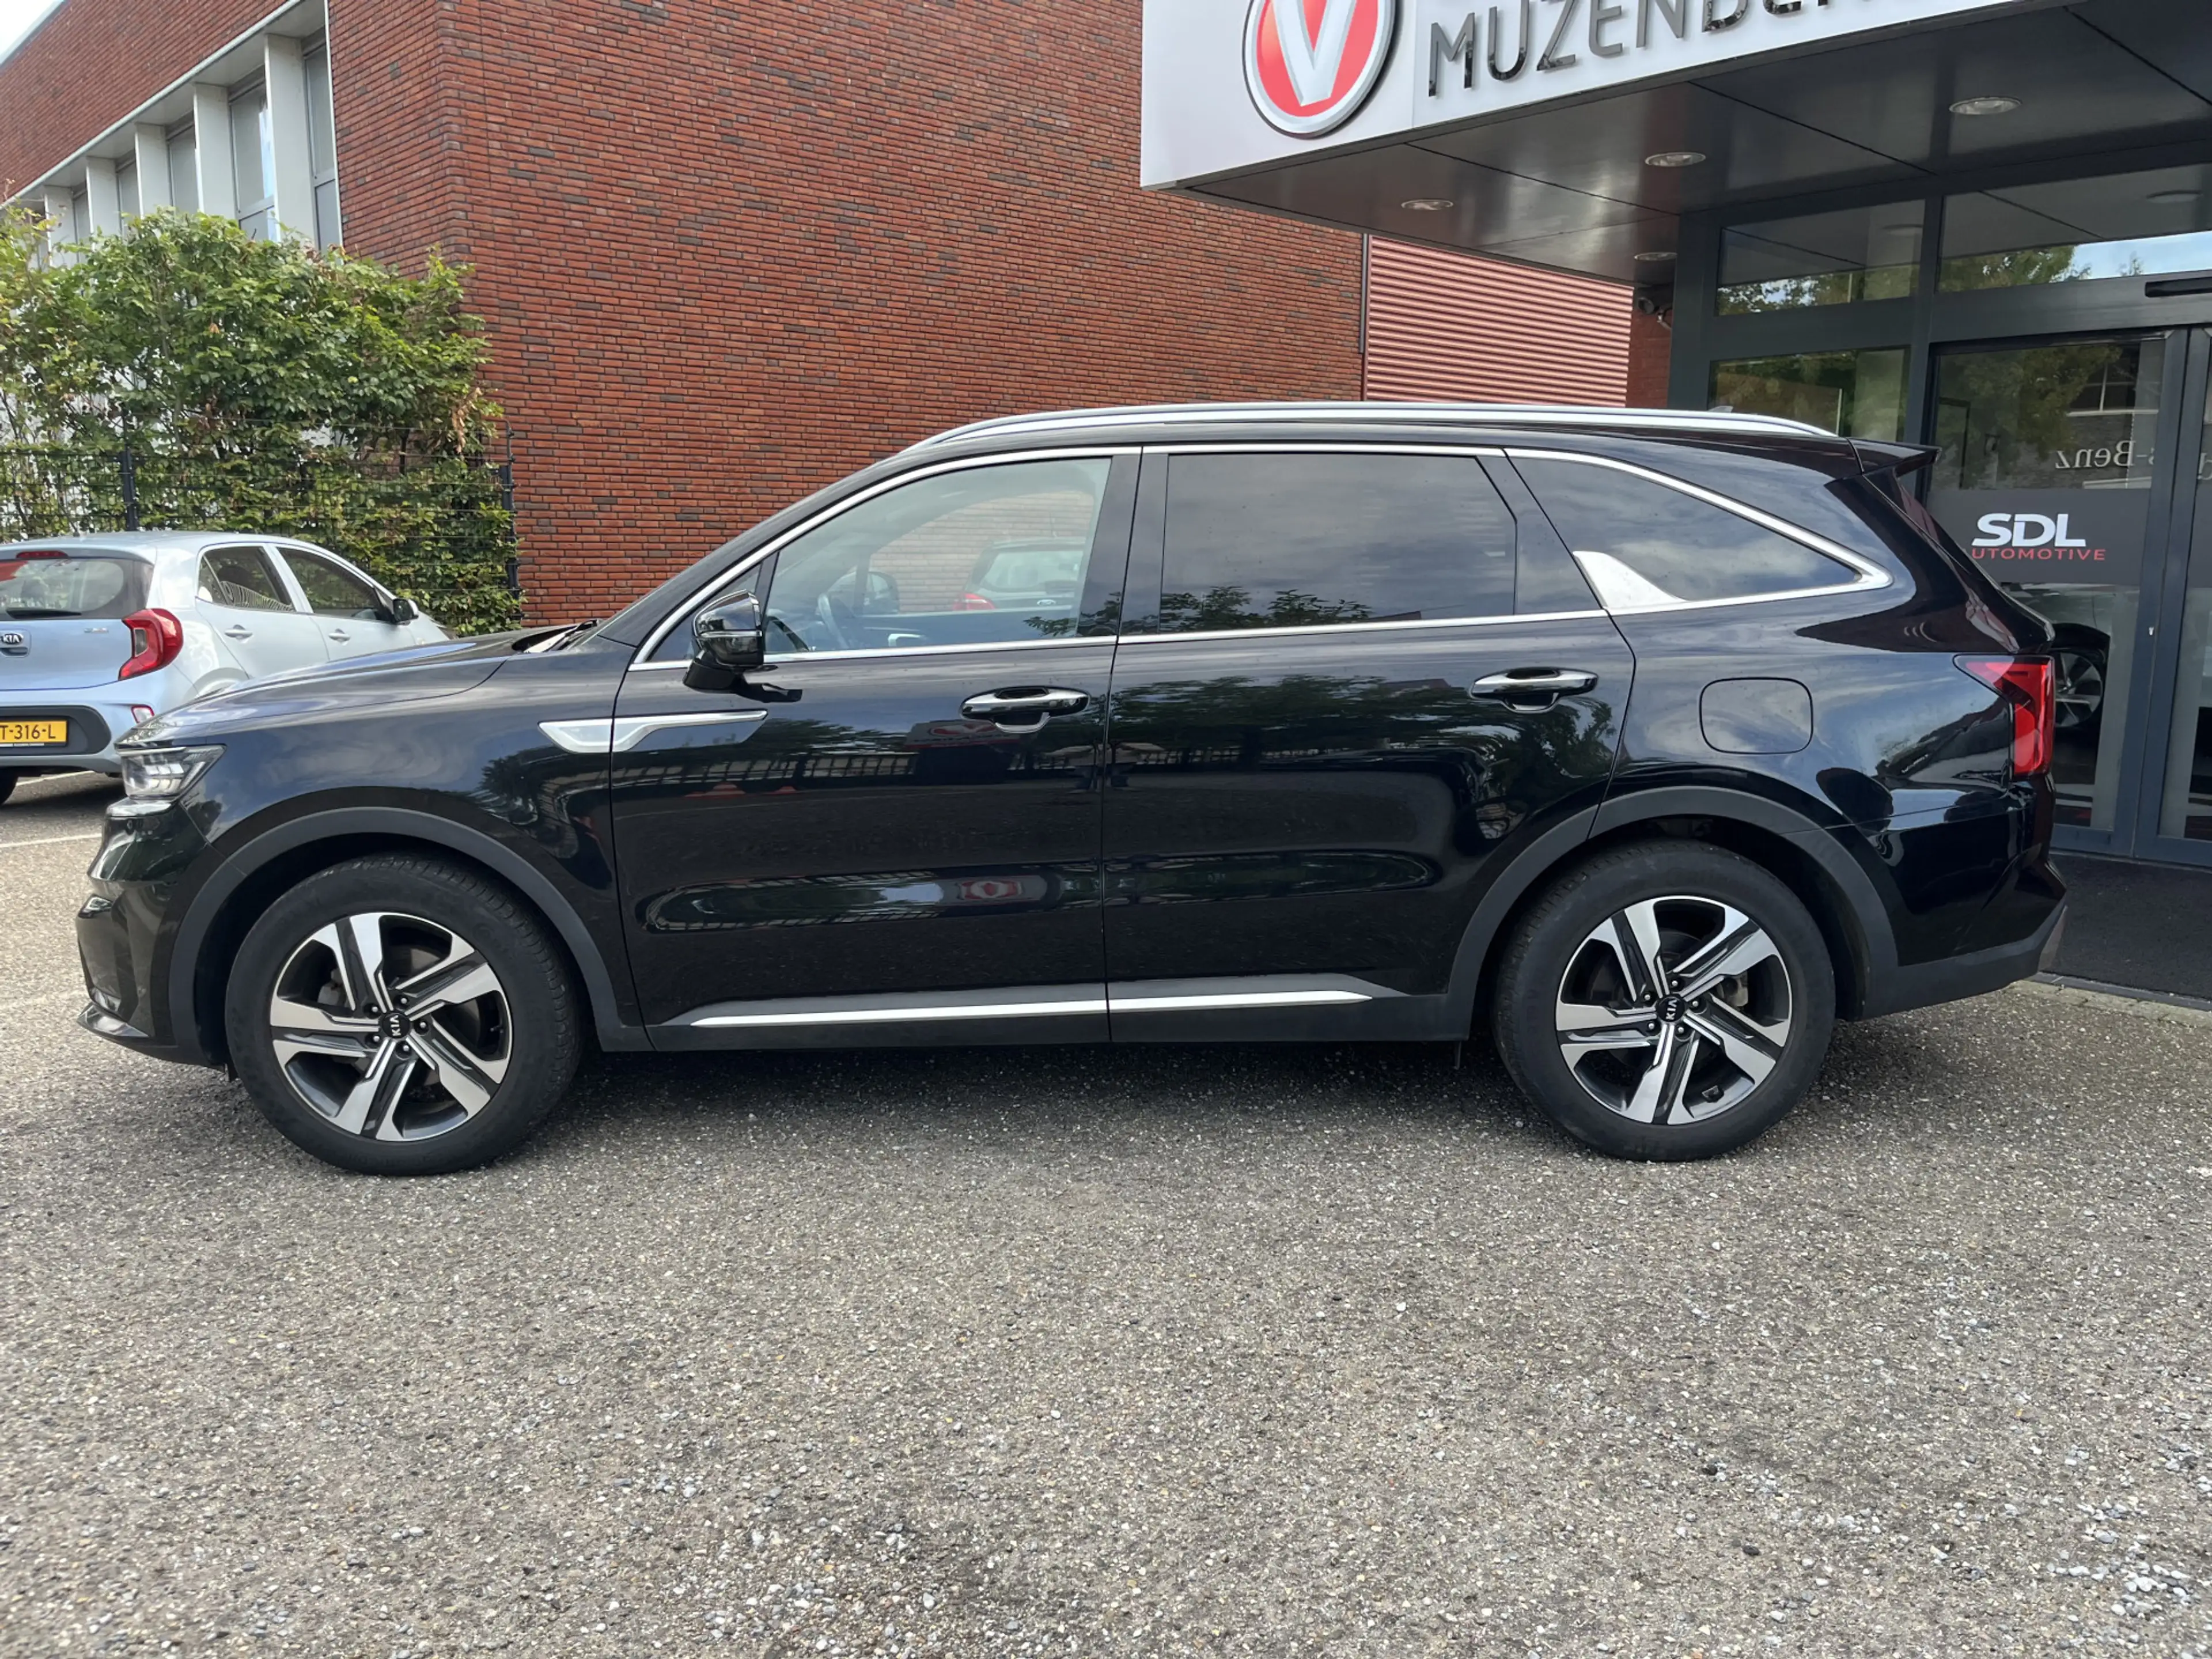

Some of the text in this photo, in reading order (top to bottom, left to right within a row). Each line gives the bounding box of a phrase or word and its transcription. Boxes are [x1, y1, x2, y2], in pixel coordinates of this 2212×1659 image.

[1428, 0, 1828, 97] MUZEND
[1971, 513, 2086, 547] SDL
[1965, 548, 2106, 560] UTOMOTIVE
[3, 635, 20, 643] KIA
[1665, 999, 1677, 1020] KIA
[389, 1015, 401, 1036] KIA
